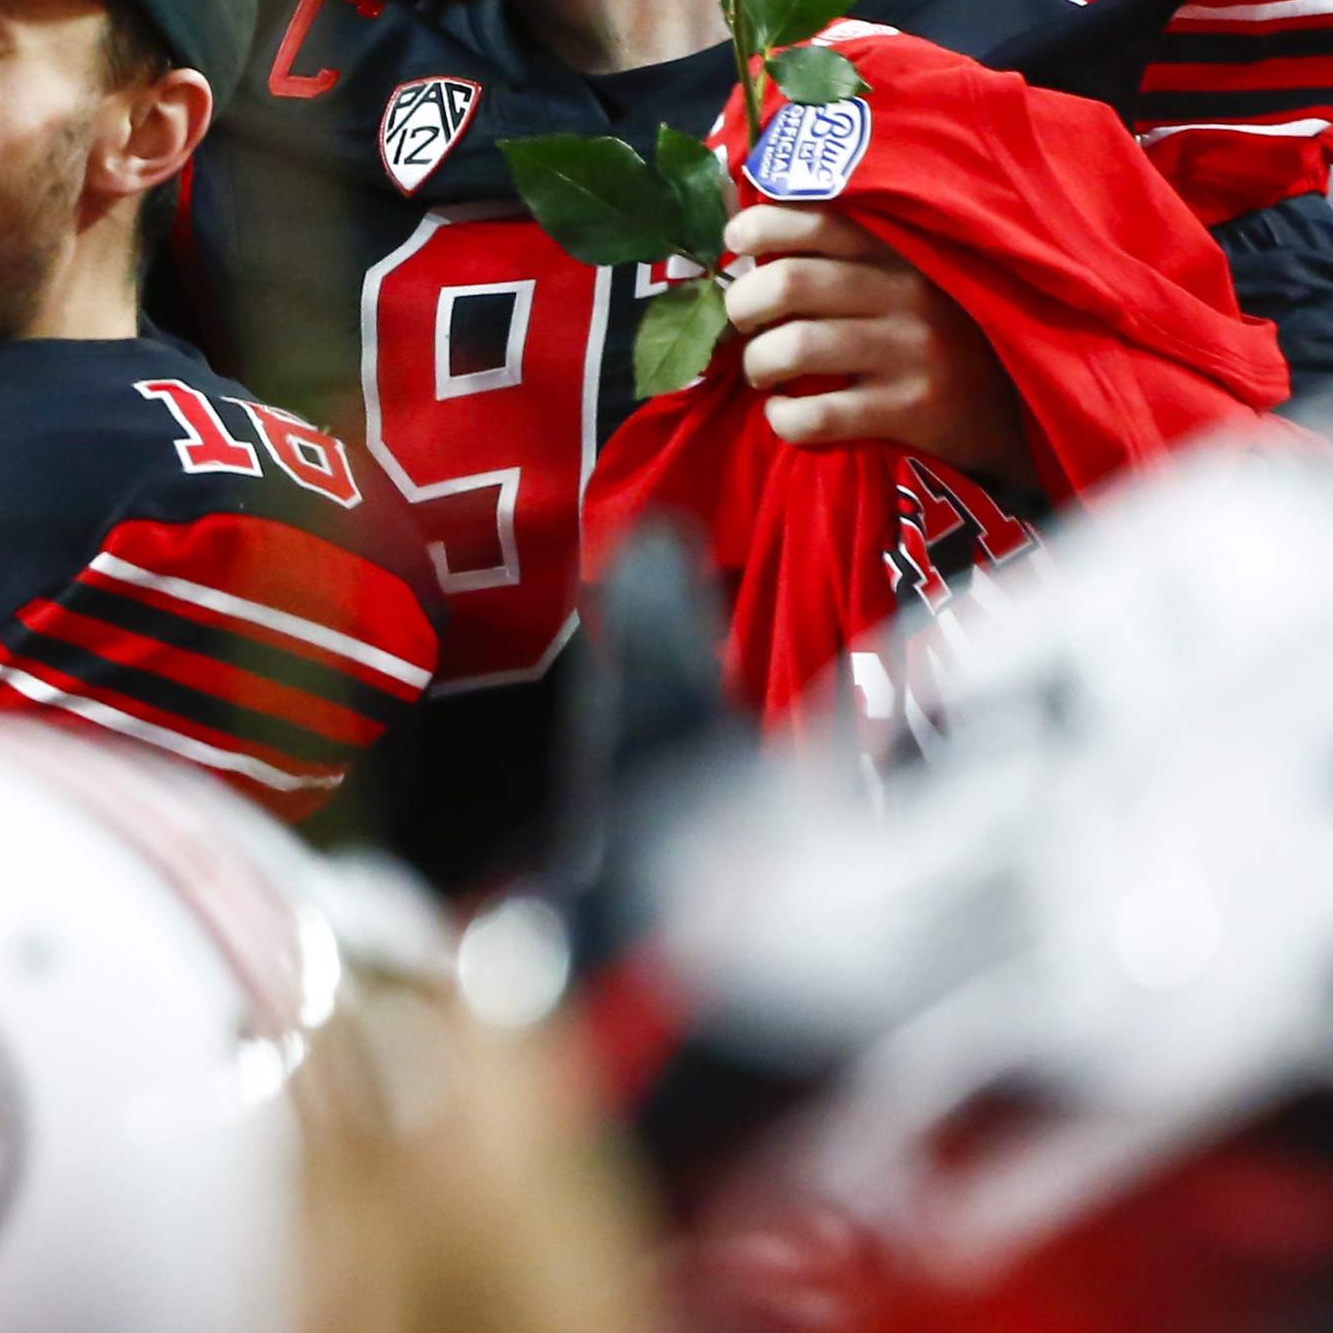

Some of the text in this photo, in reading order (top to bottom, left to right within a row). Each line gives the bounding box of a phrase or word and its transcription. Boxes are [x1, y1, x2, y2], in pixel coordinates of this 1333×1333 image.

[386, 81, 474, 146] PAC
[393, 125, 441, 166] 12
[771, 104, 805, 183] OFFICIAL
[131, 378, 364, 510] 16
